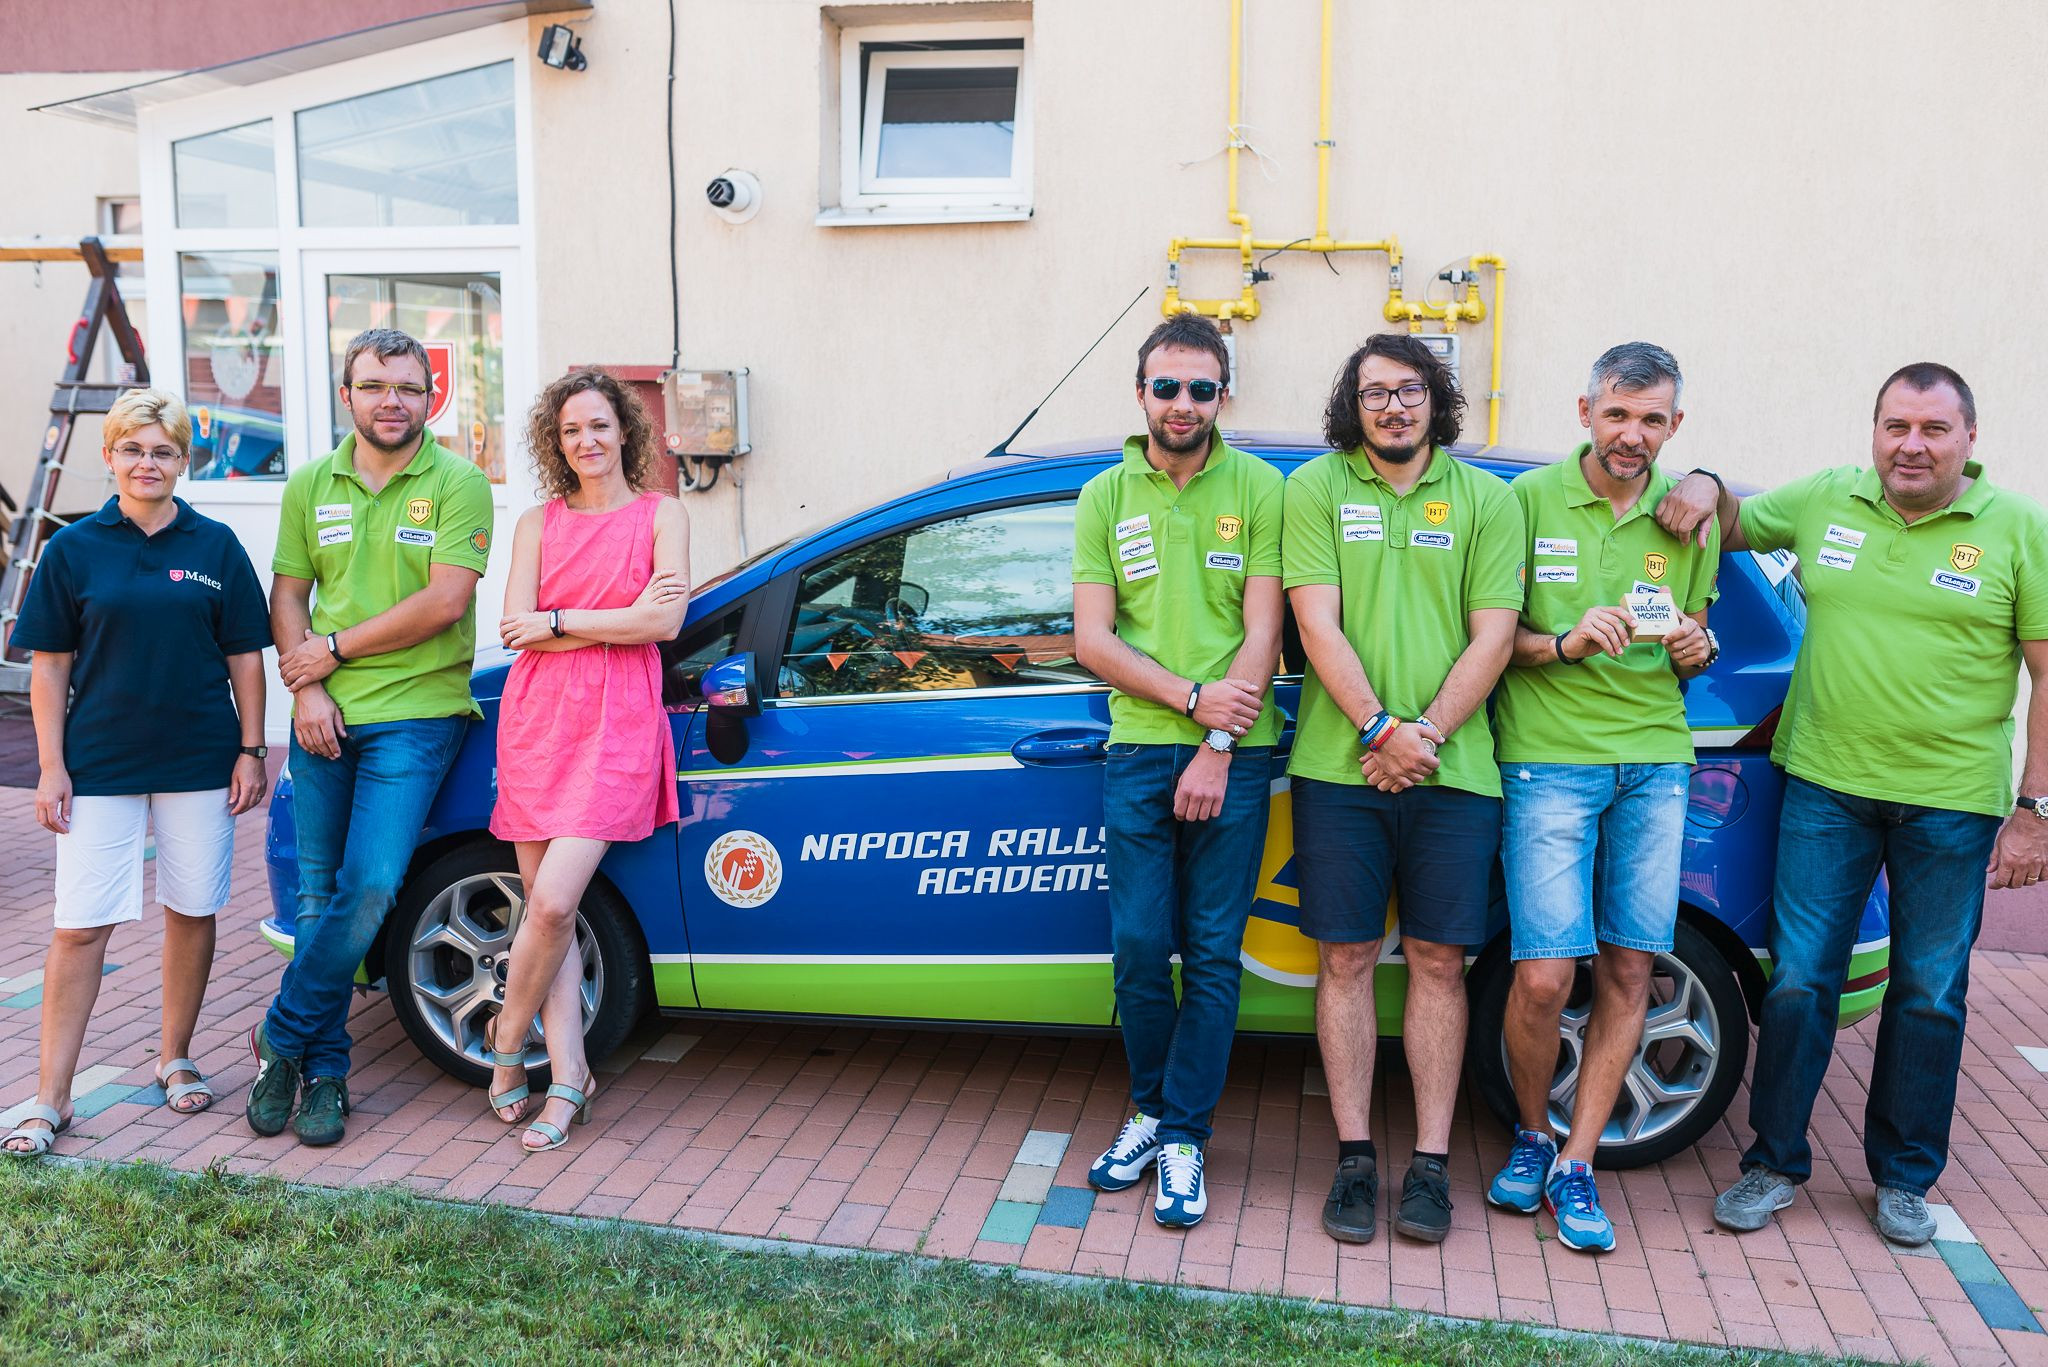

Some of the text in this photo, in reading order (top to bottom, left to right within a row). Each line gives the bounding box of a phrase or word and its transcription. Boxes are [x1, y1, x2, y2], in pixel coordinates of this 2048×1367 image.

[1221, 523, 1237, 532] BT
[1957, 551, 1975, 562] BT
[1649, 560, 1663, 571] BT
[184, 569, 222, 591] Maltez
[1631, 604, 1671, 612] WALKING
[1637, 612, 1670, 620] MONTH
[800, 826, 1107, 862] NAPOCA RALL
